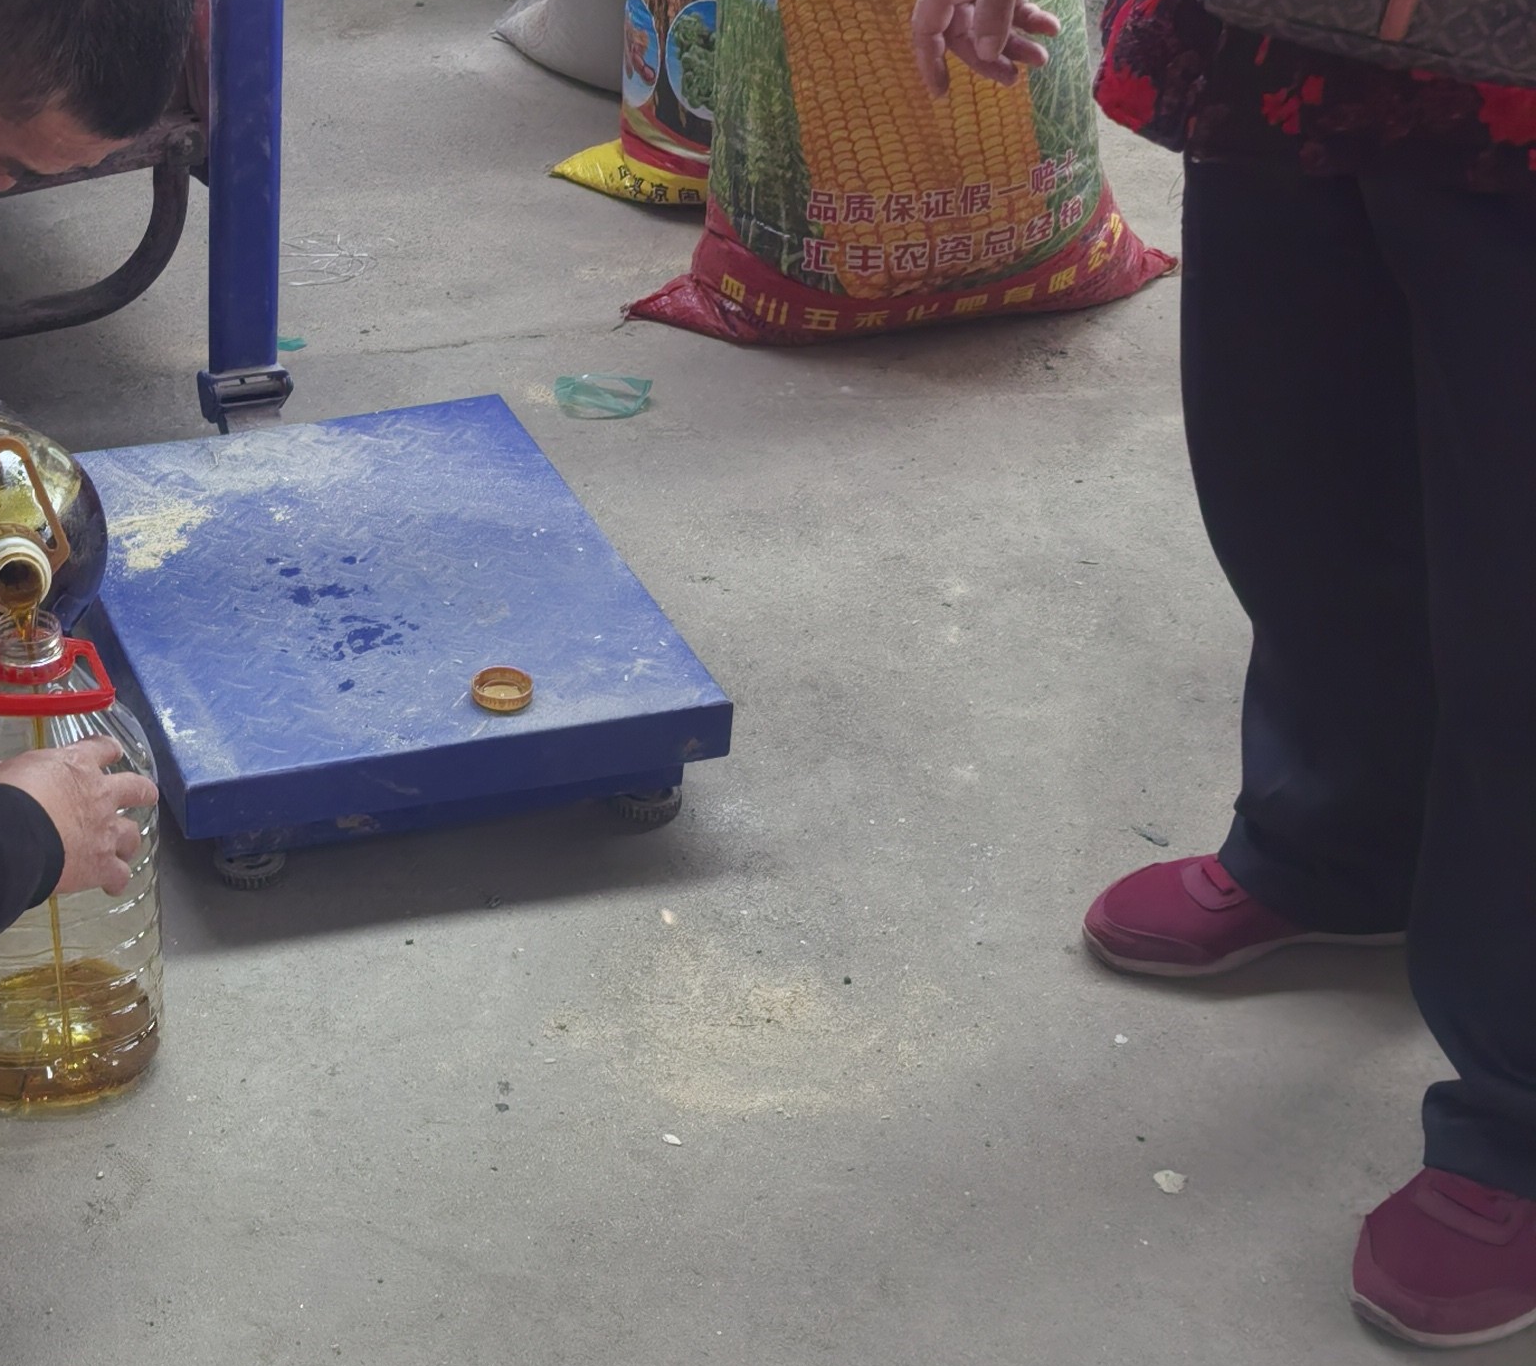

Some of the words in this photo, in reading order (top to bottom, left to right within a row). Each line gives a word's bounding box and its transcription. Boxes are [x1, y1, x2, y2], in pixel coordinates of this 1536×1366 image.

[806, 148, 1080, 225] 品质保证假一赔十
[801, 194, 1085, 276] 汇丰农资总经销
